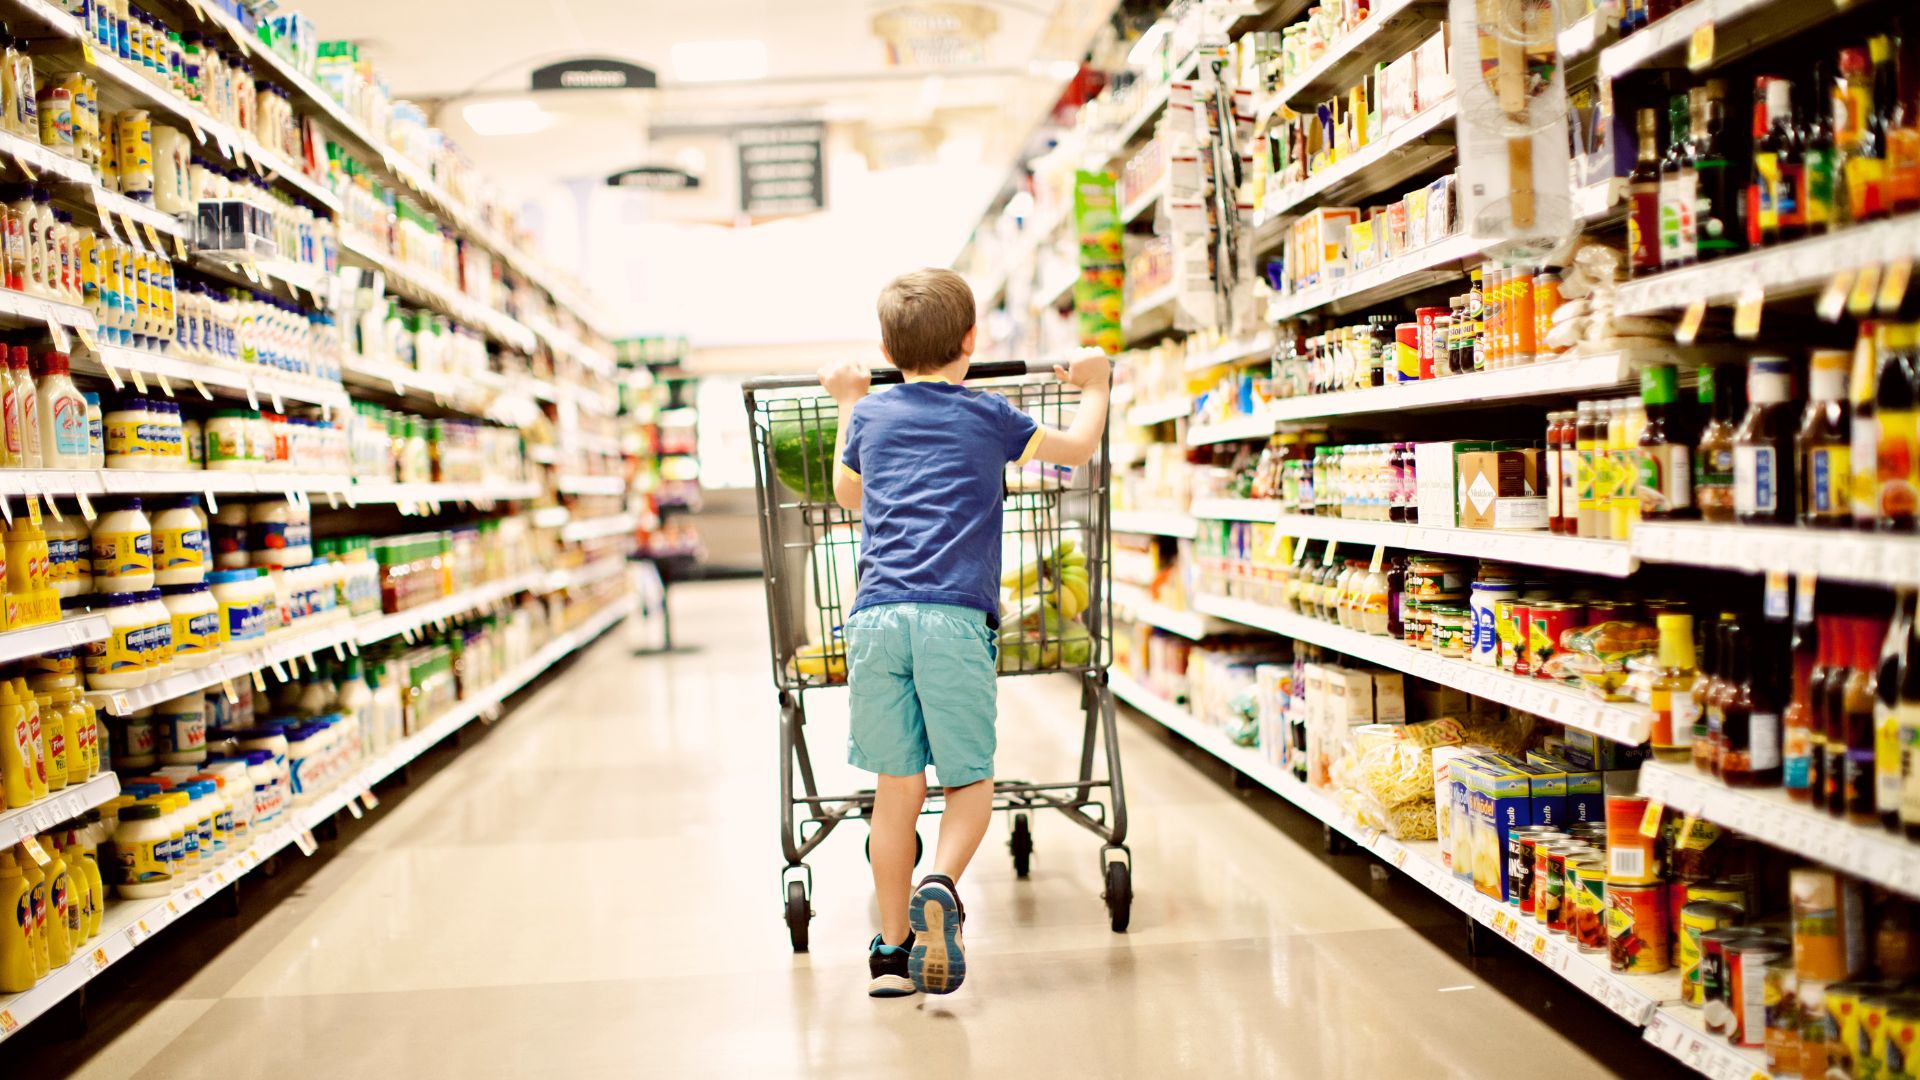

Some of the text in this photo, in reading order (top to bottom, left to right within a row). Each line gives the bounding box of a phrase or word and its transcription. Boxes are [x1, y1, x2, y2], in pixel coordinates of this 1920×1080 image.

[1507, 806, 1516, 826] halb
[1544, 805, 1552, 824] halb
[1578, 802, 1586, 821] halb
